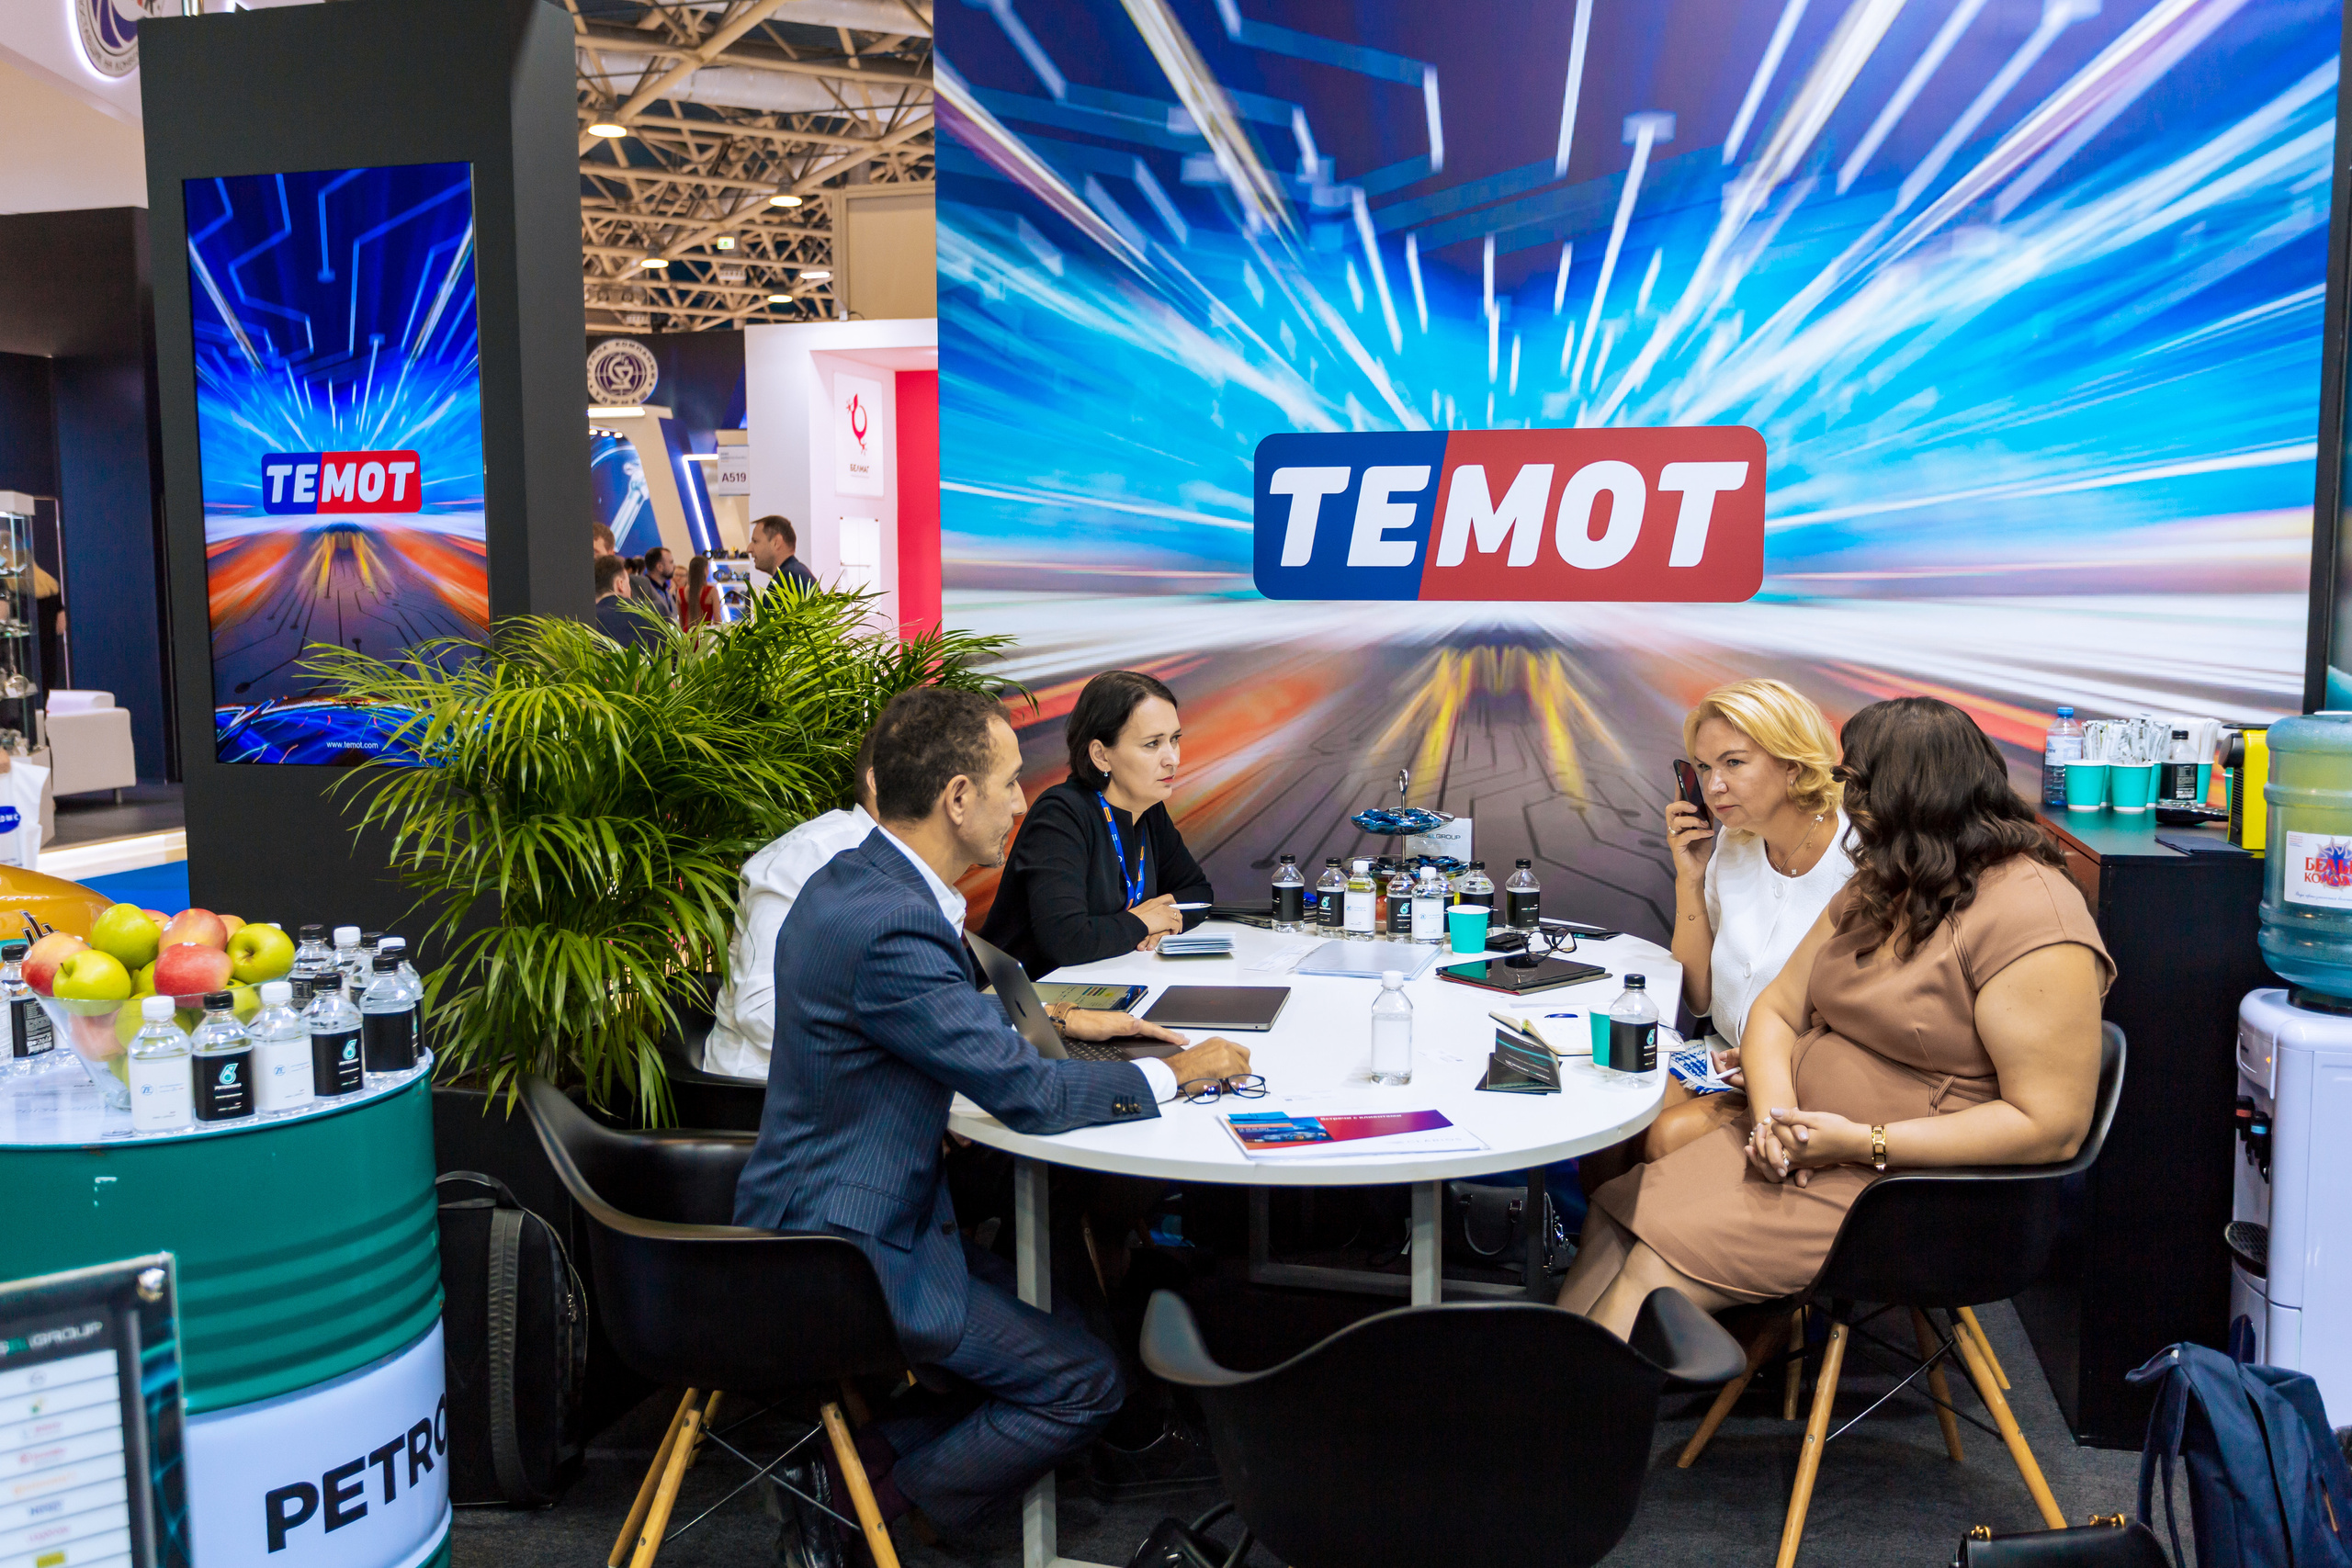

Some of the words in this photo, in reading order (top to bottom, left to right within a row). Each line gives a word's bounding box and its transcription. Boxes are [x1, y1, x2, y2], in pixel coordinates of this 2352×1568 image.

[266, 461, 416, 503] TEMOT
[722, 472, 747, 483] A519
[1269, 460, 1749, 570] TEMOT
[326, 740, 379, 750] www.temot.com
[266, 1393, 447, 1553] PETRO
